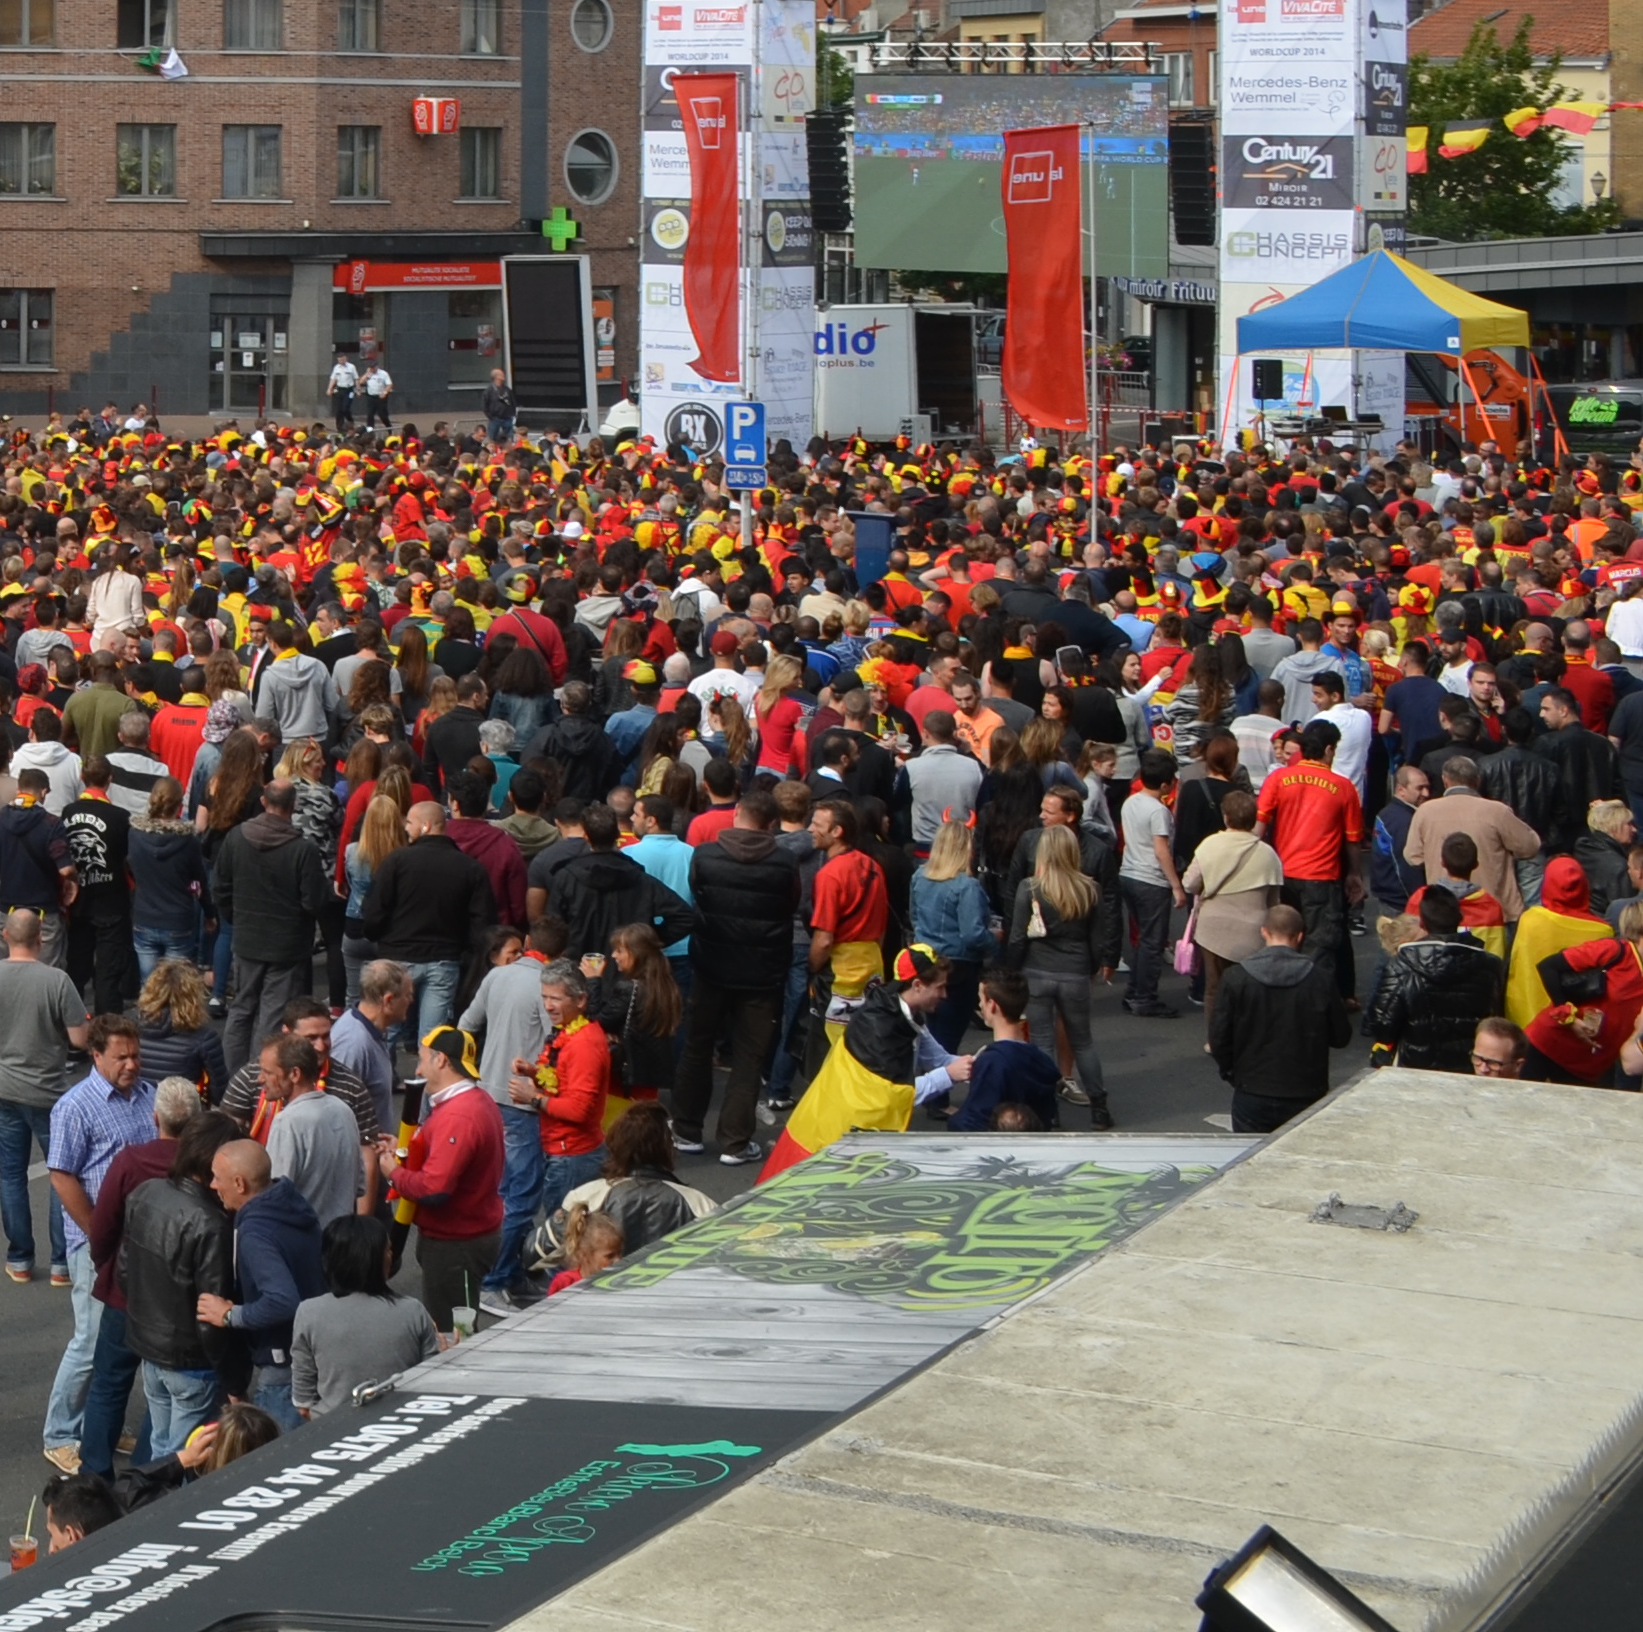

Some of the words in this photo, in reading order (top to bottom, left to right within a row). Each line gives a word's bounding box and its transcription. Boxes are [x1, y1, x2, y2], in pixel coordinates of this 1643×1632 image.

[667, 52, 709, 60] WORLDCUP
[711, 52, 729, 60] 2014
[1249, 48, 1301, 56] WORLDCUP
[1303, 48, 1325, 56] 2014
[1230, 76, 1348, 88] Mercedes-Benz
[1230, 91, 1296, 103] Wemmel
[649, 144, 688, 156] Merce
[1113, 154, 1143, 163] WORLD
[1144, 155, 1163, 164] CUP
[1242, 137, 1319, 164] Century
[650, 158, 691, 169] Wemm
[1310, 155, 1333, 179] 21
[1255, 196, 1269, 206] 02
[1271, 196, 1291, 206] 424
[1293, 196, 1306, 205] 21
[1309, 196, 1322, 206] 21
[1171, 281, 1216, 301] Frituu
[813, 322, 876, 356] dio
[680, 414, 707, 442] RX
[731, 406, 757, 440] P
[304, 541, 328, 567] 12
[1281, 774, 1338, 795] BELGIUM
[591, 1150, 902, 1290] AVENUE
[395, 1394, 478, 1416] Tel
[472, 1397, 529, 1416] Une
[422, 1413, 491, 1445] soirée
[311, 1423, 419, 1462] 0475
[369, 1443, 447, 1474] Mojito
[264, 1463, 341, 1486] 44
[326, 1471, 387, 1498] pour
[222, 1485, 302, 1508] 28
[278, 1494, 345, 1523] votre
[178, 1509, 258, 1532] 01
[103, 1564, 221, 1616] N'hésitez
